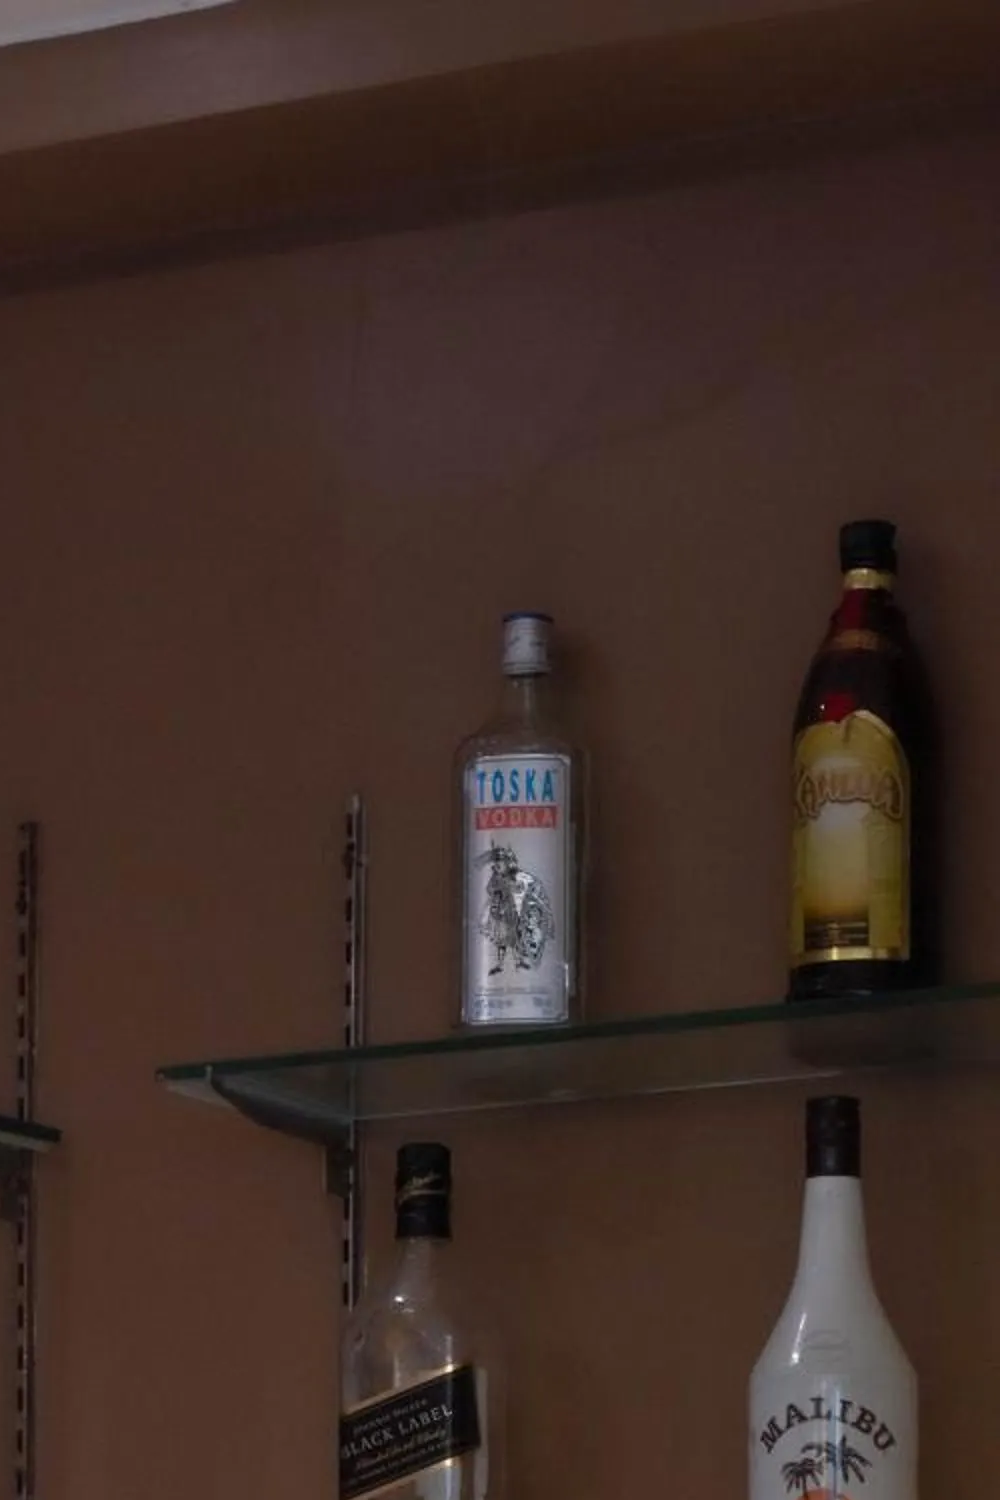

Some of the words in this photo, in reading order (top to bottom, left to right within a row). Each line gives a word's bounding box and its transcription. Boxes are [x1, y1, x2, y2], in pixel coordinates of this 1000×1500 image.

[475, 766, 555, 803] TOSKA
[477, 807, 555, 829] VODKA
[397, 1403, 454, 1437] LABEL
[760, 1395, 896, 1454] MALIBU
